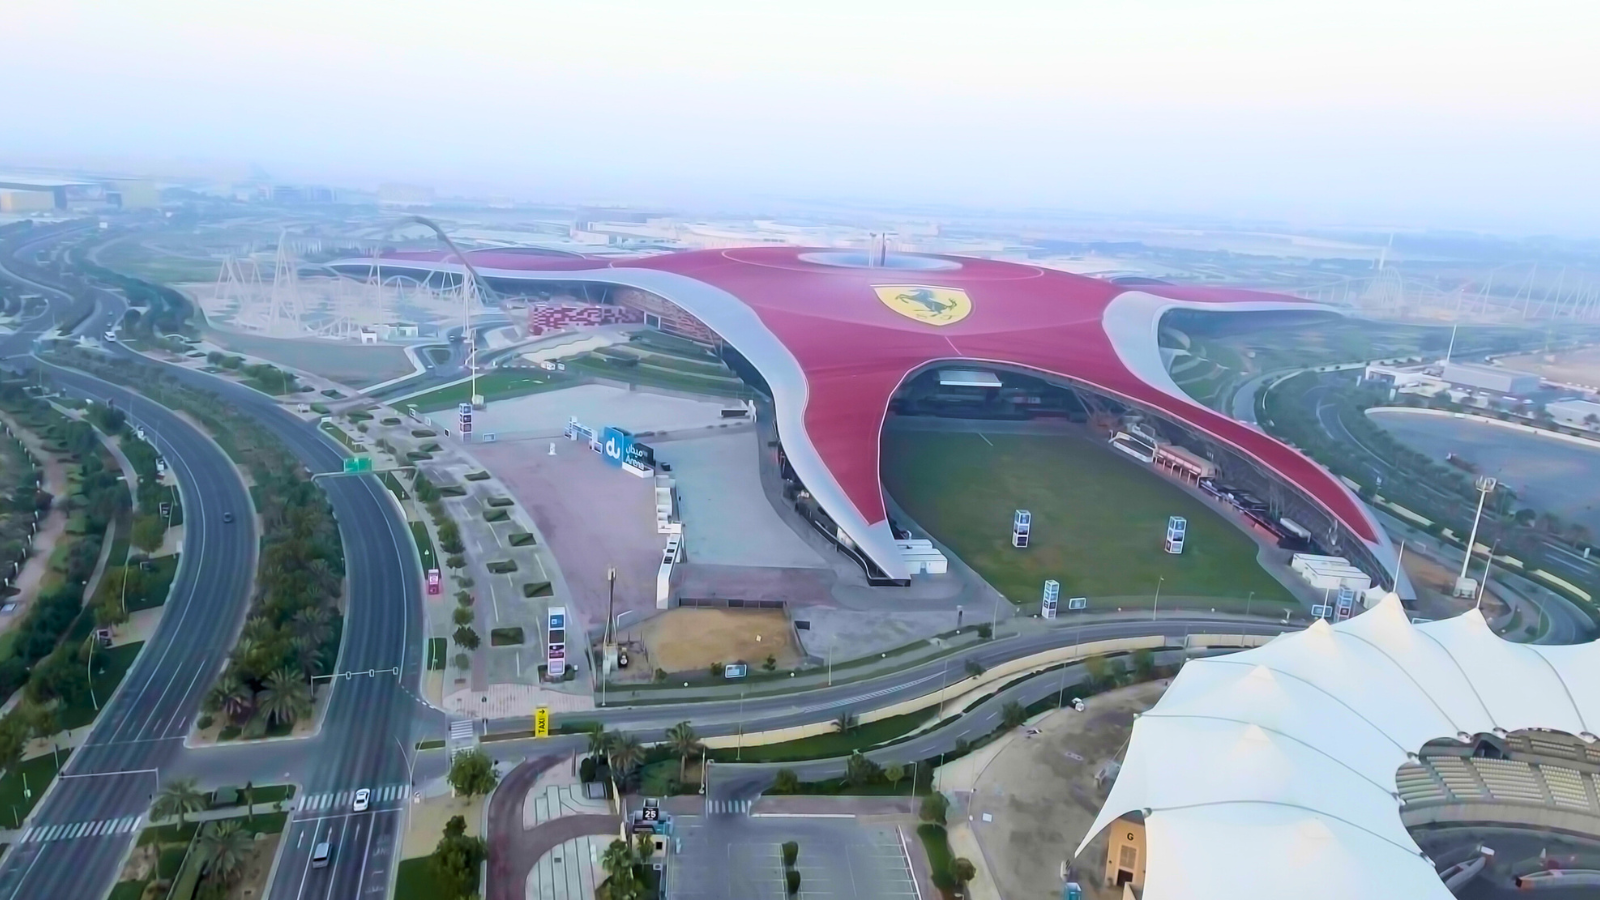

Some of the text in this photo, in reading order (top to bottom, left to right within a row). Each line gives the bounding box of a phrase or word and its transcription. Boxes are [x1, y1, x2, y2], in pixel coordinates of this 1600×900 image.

[606, 437, 620, 459] du
[625, 454, 645, 470] Arena
[644, 810, 657, 818] 25
[1127, 832, 1134, 841] G
